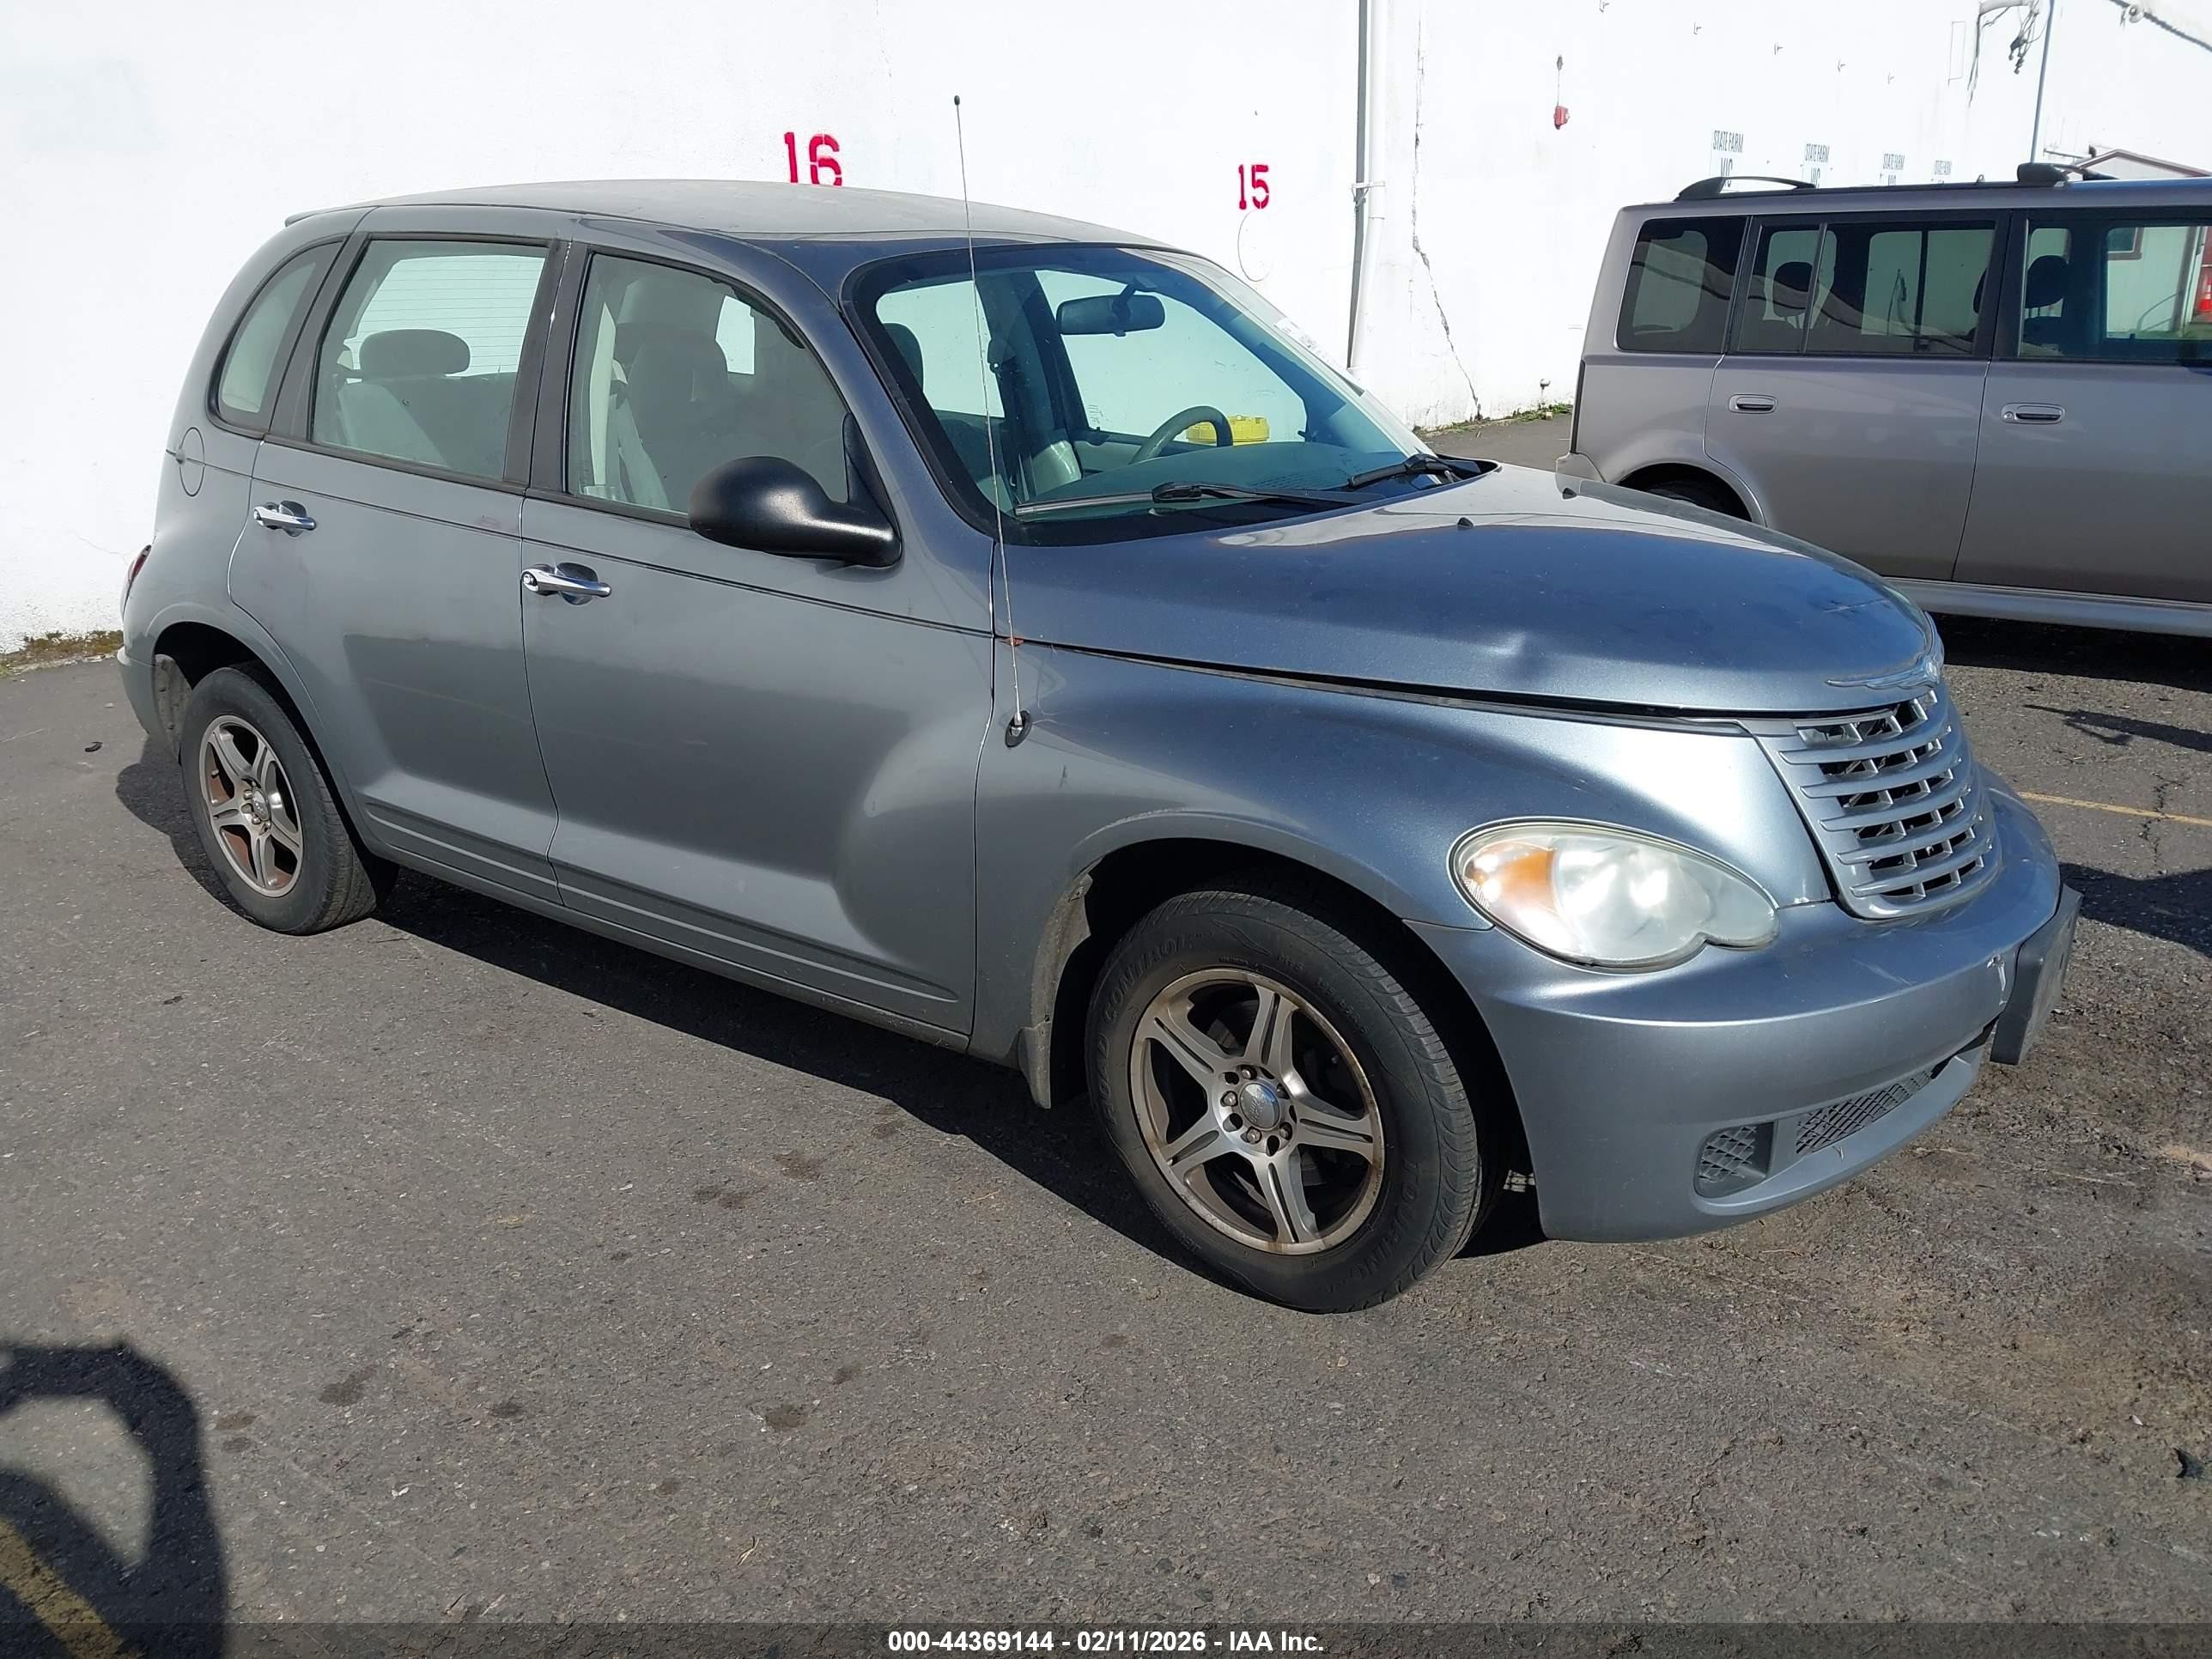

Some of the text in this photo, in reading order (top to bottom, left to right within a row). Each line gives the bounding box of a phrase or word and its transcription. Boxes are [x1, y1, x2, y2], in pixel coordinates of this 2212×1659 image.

[784, 131, 842, 186] 16
[1712, 130, 1744, 153] STATE FARM
[1805, 143, 1817, 161] STATE
[1239, 164, 1269, 210] 15
